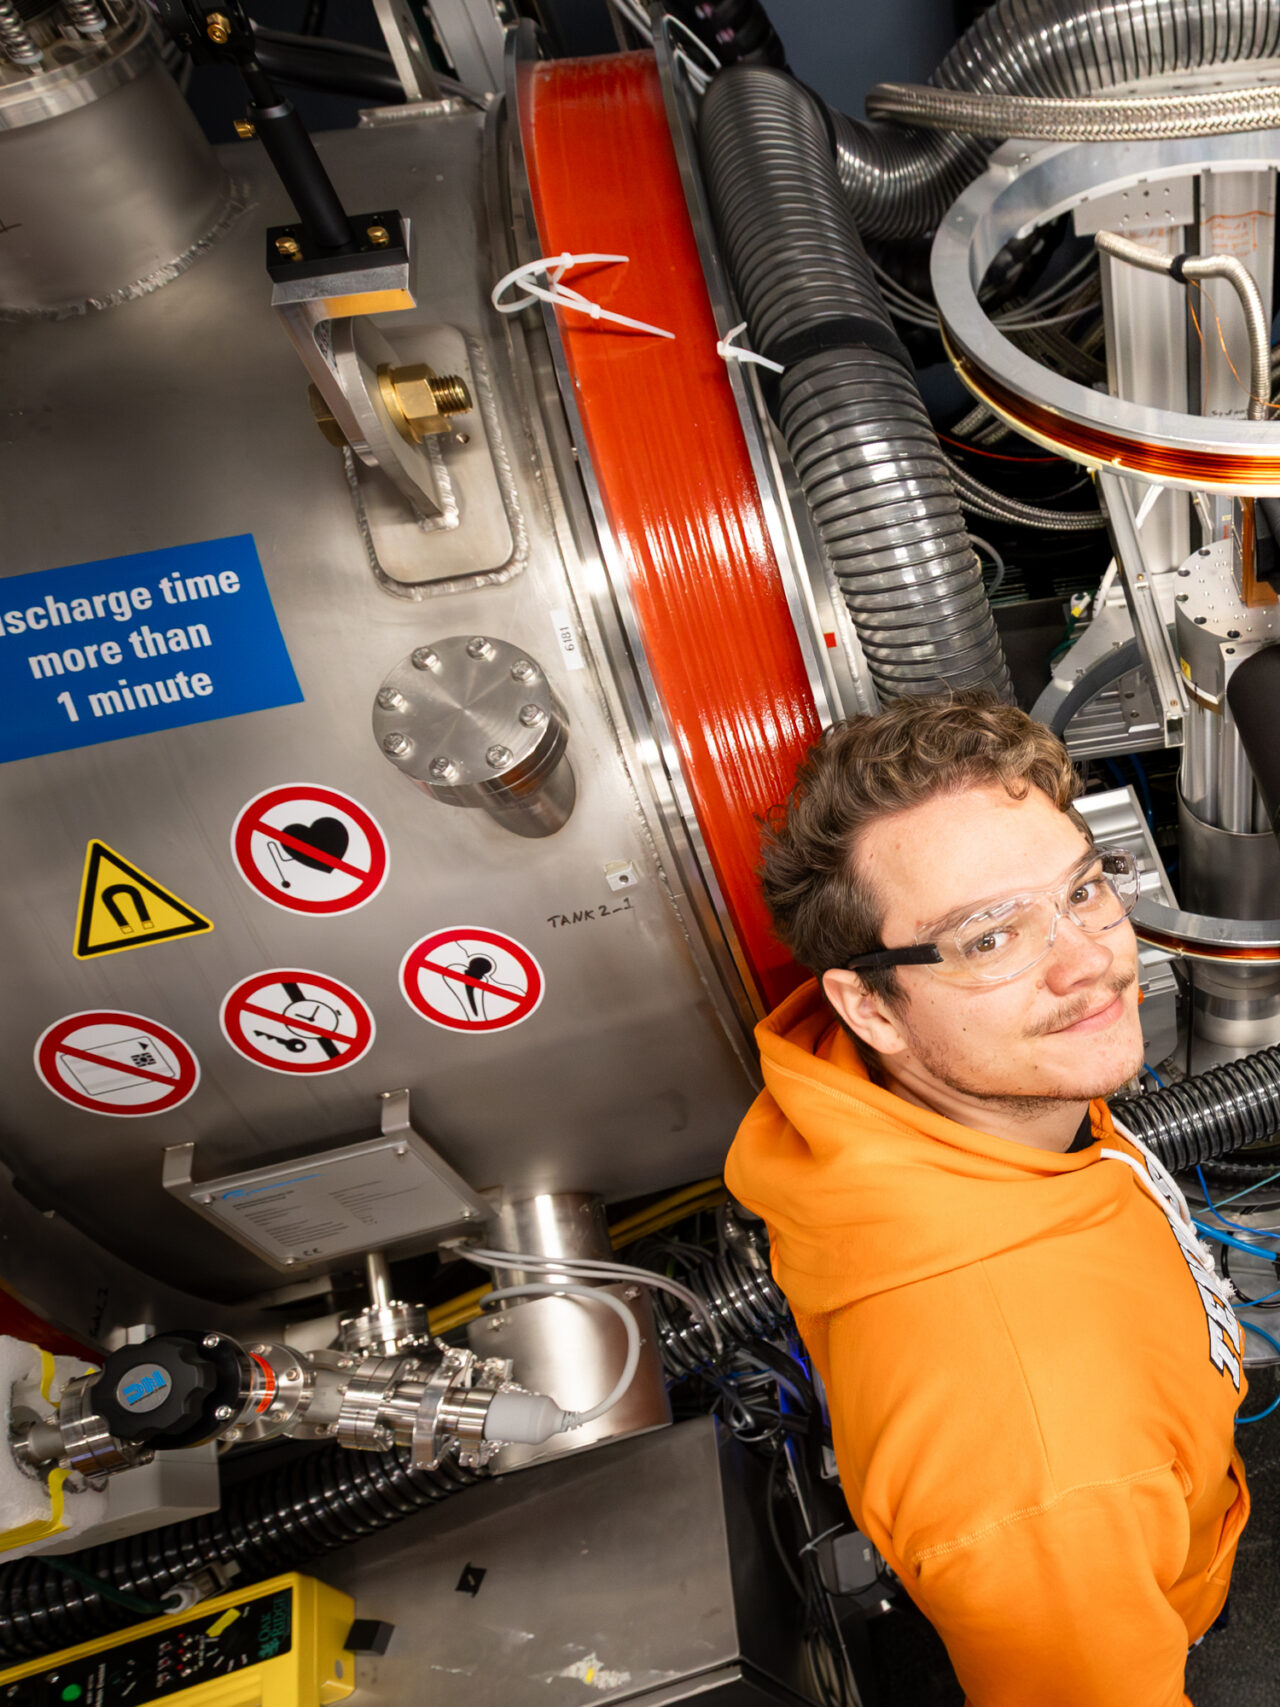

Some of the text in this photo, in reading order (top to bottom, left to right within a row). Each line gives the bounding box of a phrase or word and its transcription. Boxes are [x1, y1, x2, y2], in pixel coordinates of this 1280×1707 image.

[159, 570, 241, 605] time
[28, 624, 213, 680] more than
[559, 626, 576, 652] 6181
[56, 671, 214, 722] 1 minute
[547, 910, 595, 928] TANK
